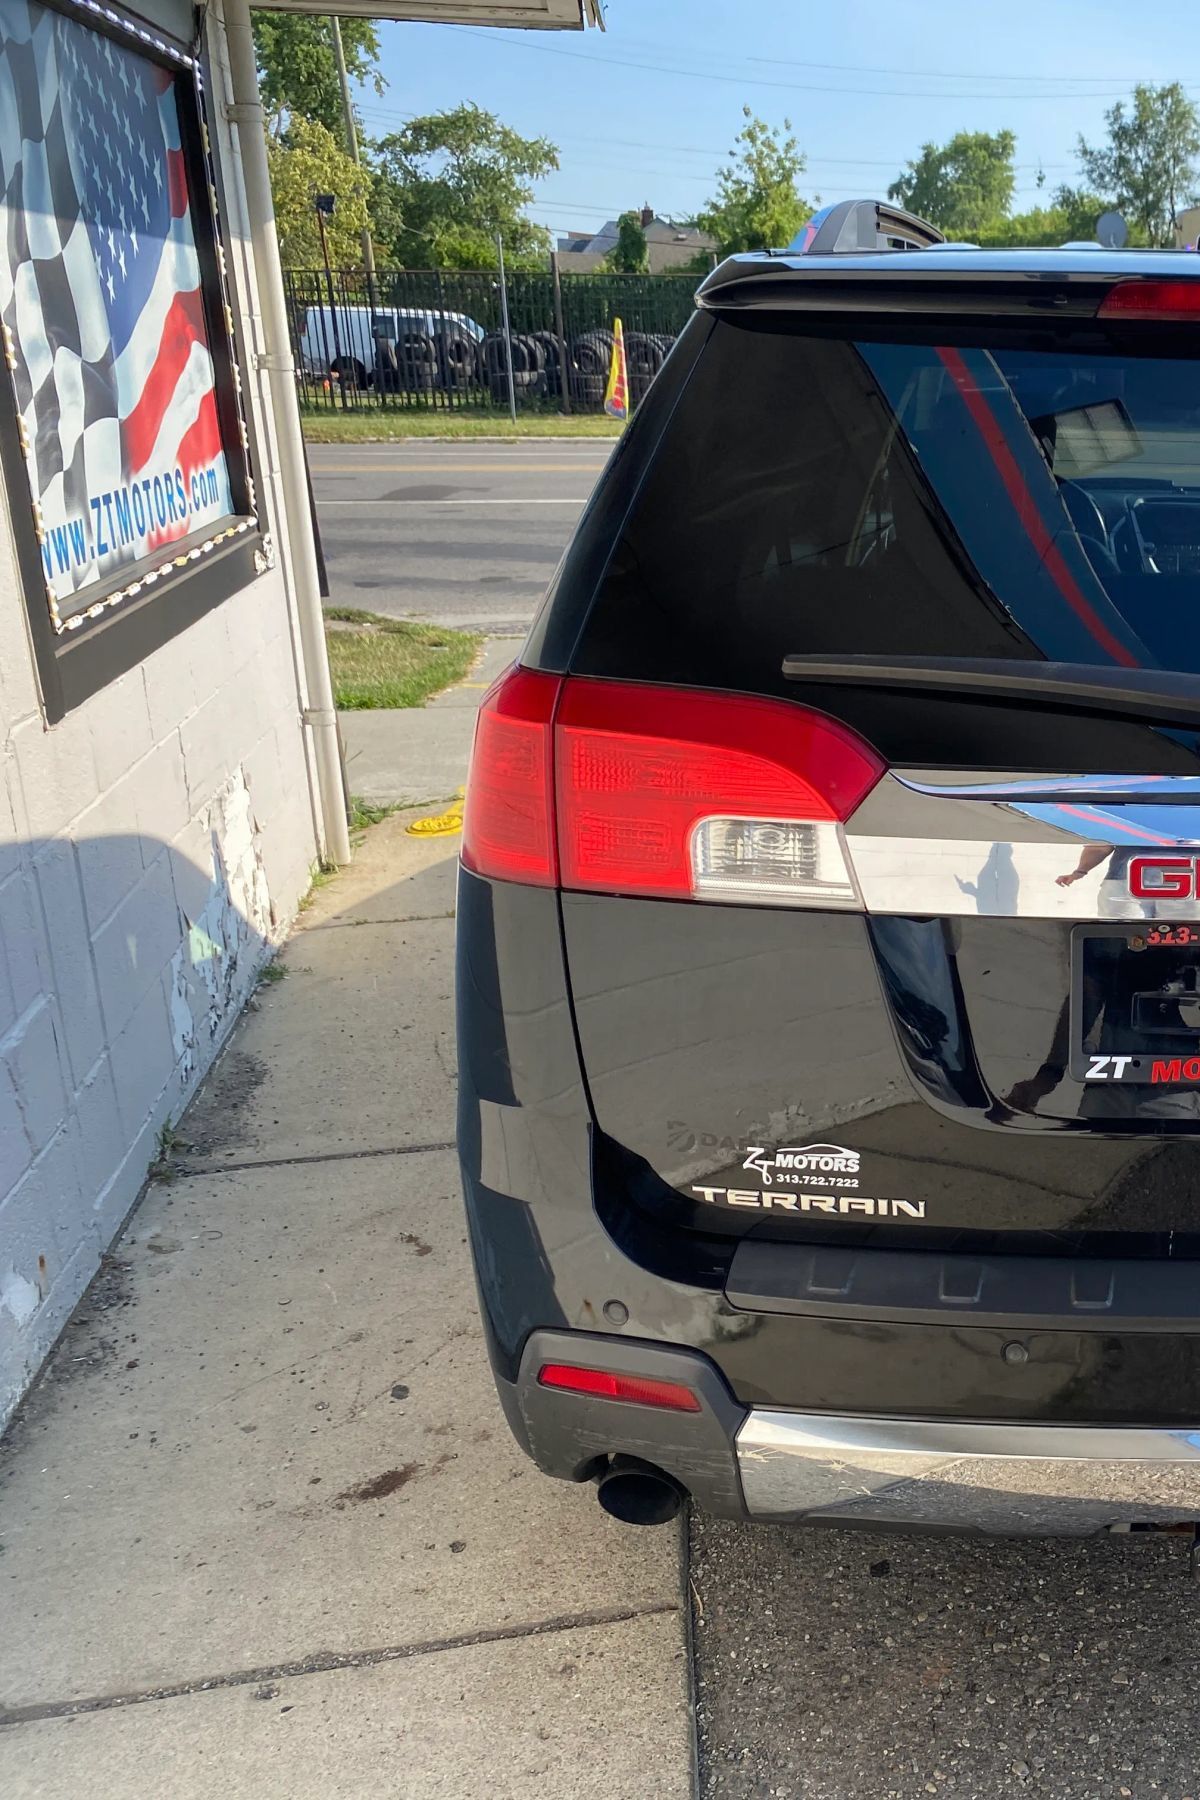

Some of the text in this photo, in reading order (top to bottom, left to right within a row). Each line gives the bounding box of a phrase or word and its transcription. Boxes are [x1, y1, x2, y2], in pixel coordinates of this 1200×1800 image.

[1085, 1056, 1132, 1079] ZT
[775, 1154, 861, 1173] MOTORS
[776, 1173, 860, 1188] 313.722.7222
[691, 1184, 926, 1218] TERRAIN
